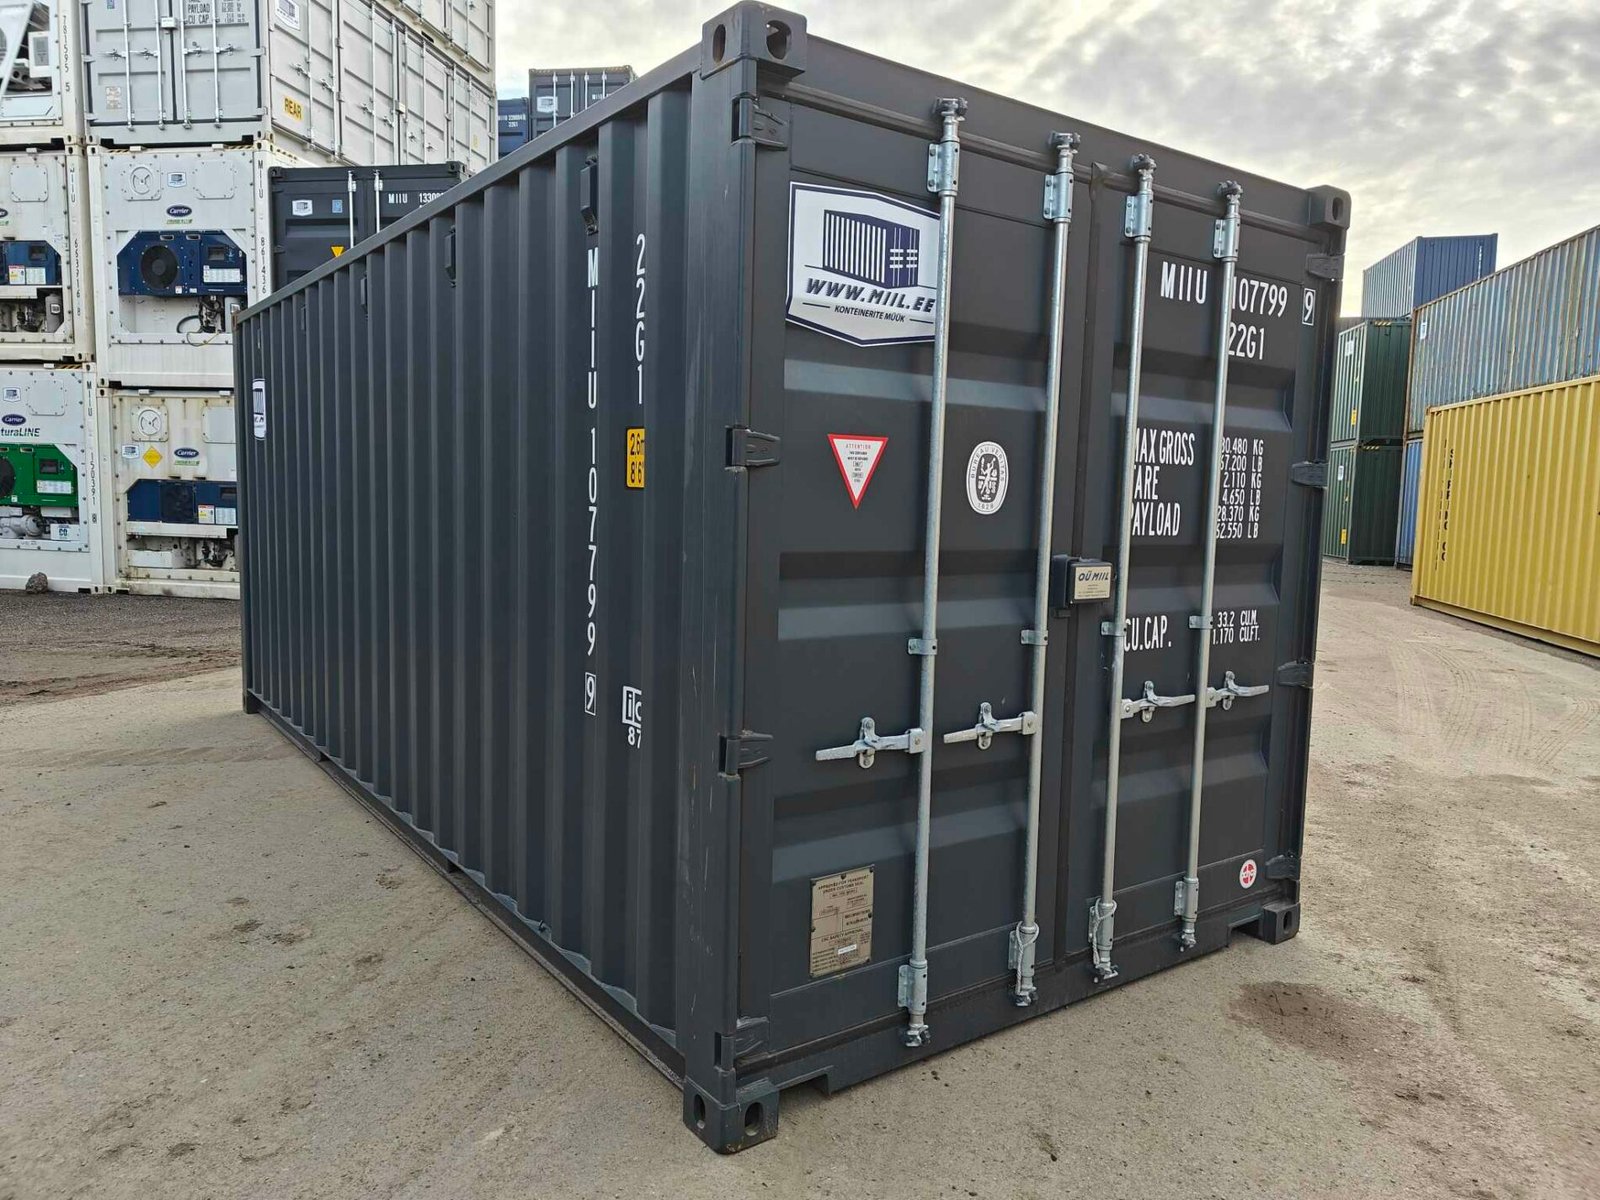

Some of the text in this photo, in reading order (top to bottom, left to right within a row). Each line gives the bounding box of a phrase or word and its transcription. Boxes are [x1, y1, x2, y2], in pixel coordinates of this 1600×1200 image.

[188, 3, 210, 13] PAYLOAD
[199, 14, 209, 23] CAP
[284, 97, 302, 119] REAR
[388, 193, 408, 204] MIIU
[806, 278, 935, 312] WWW.MIIL.EE
[1160, 261, 1315, 324] MIIU 107799 9
[635, 233, 646, 405] 22G1
[834, 304, 905, 322] KONTEINERITE MÜÜK
[1228, 321, 1265, 360] 22G1
[1160, 430, 1195, 466] GROSS
[1253, 439, 1264, 455] KG
[1252, 456, 1262, 472] LB
[586, 247, 598, 713] MIIU 107799 9
[1223, 472, 1262, 489] 2.110 KG
[1222, 489, 1260, 506] 4.650 LB
[1217, 505, 1260, 522] 28.370 KG
[1247, 523, 1259, 539] LB
[1092, 571, 1109, 581] MIIL
[1217, 611, 1235, 628] 33.2
[1124, 615, 1172, 652] CU.CAP.
[1213, 627, 1234, 645] 1.170
[628, 726, 642, 748] 87
